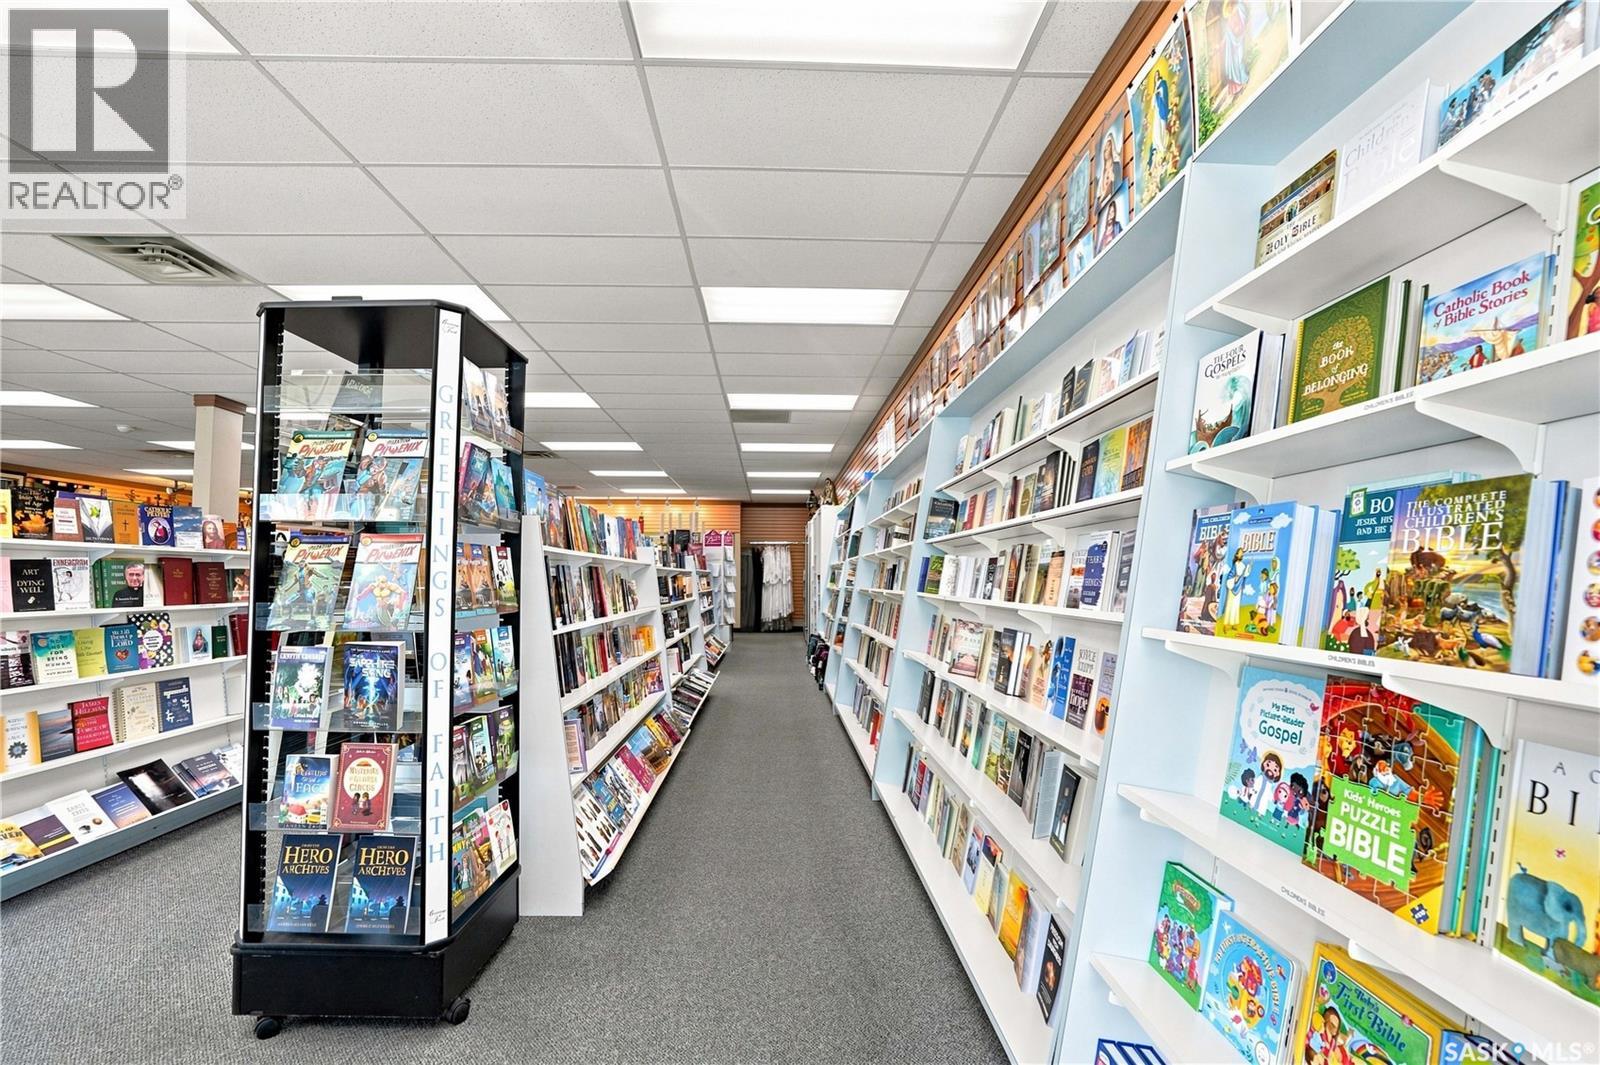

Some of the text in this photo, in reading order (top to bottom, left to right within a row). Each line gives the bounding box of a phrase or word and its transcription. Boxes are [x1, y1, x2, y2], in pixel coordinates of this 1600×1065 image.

[1434, 270, 1531, 317] Catholic Book
[1433, 288, 1529, 329] of Bible Stories
[1204, 351, 1247, 379] GOSPELS
[1319, 346, 1355, 368] BOOK
[1302, 363, 1369, 396] BELONGING
[1331, 362, 1341, 375] of
[1406, 499, 1506, 518] ILLUSTRATED
[1407, 490, 1508, 512] THE COMPLETE
[1404, 509, 1505, 529] CHILDREN'S
[1242, 531, 1277, 553] BIBLE
[1400, 521, 1504, 553] BIBLE
[22, 568, 40, 576] ART
[428, 384, 454, 863] GREETINGS OF FAITH
[1258, 720, 1303, 746] Gospel
[1552, 761, 1566, 776] A
[1343, 788, 1401, 818] Kids' Heroes
[1340, 801, 1402, 840] PUZZLE
[283, 845, 334, 865] HERO
[358, 847, 410, 866] HERO
[1328, 816, 1408, 877] BIBLE
[282, 864, 330, 875] ARCHIVES
[358, 866, 407, 876] ARCHIVES
[1333, 981, 1408, 1053] First Bible
